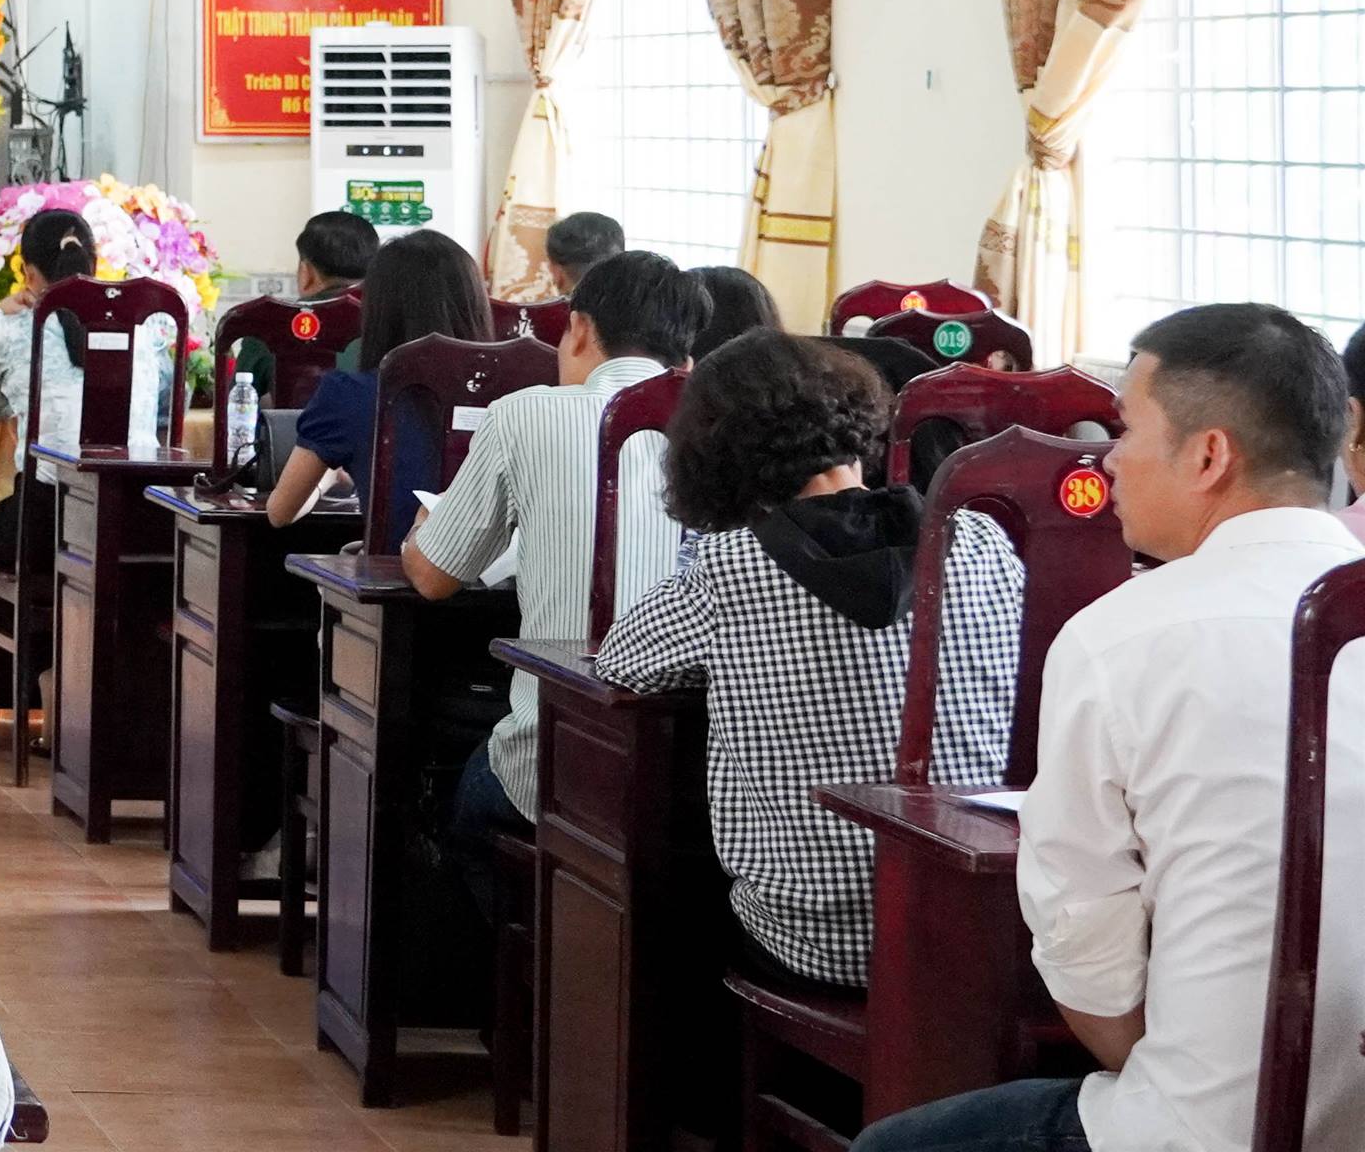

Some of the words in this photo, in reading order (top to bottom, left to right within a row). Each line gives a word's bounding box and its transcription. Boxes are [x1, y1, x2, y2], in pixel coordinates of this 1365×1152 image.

[300, 317, 311, 334] 3
[938, 332, 965, 348] 019
[1067, 478, 1101, 508] 38
